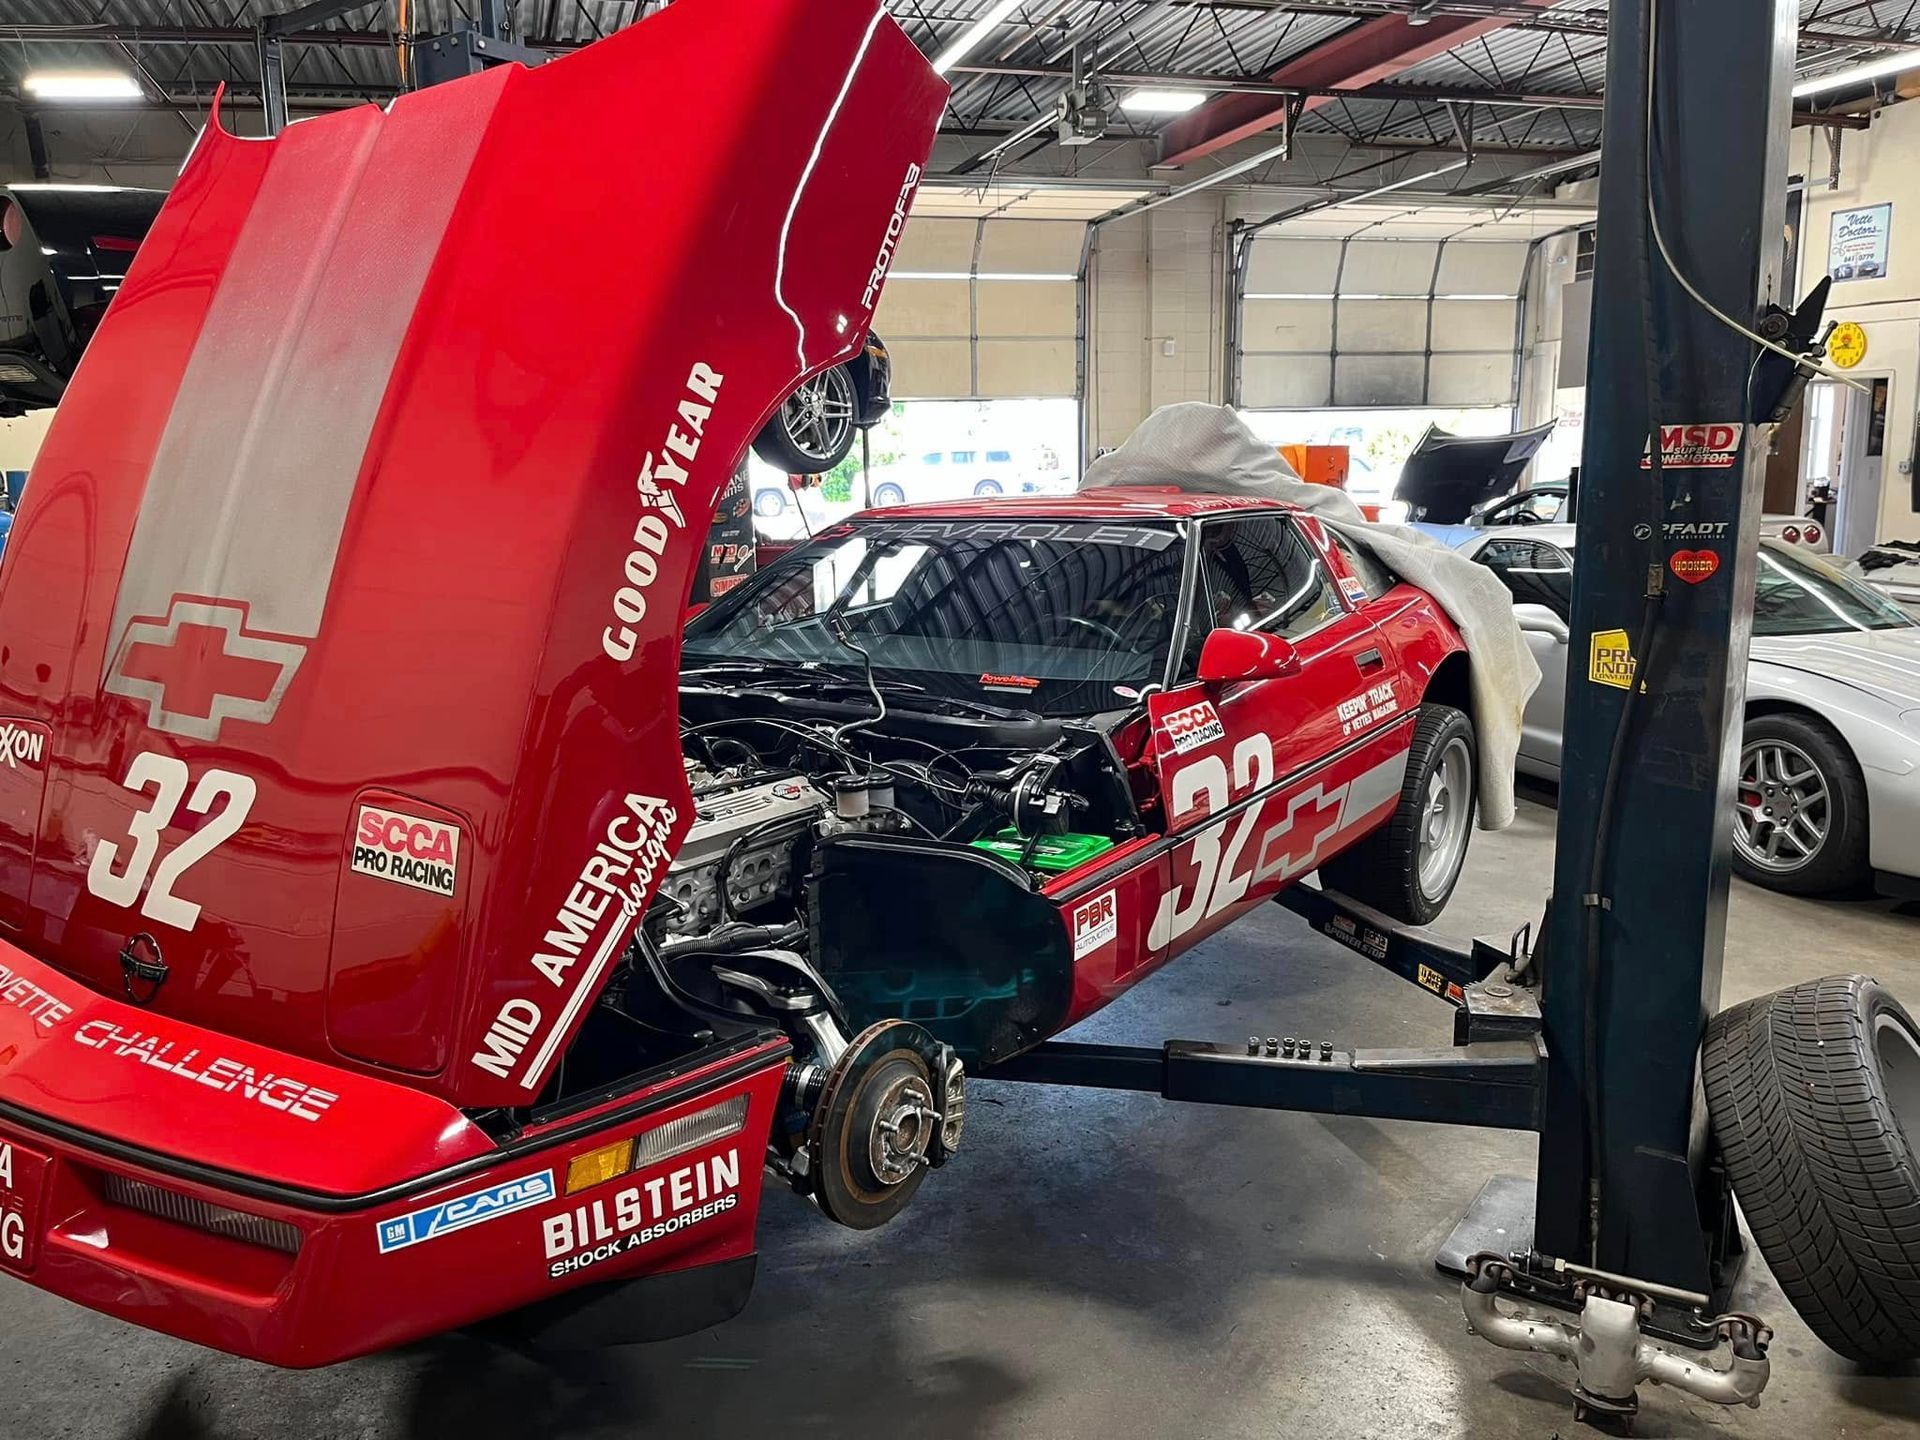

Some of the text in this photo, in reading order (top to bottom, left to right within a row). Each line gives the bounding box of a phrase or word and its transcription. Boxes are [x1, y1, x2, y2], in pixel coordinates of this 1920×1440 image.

[860, 162, 921, 310] PROTOFAB
[1672, 446, 1711, 455] SUPER
[853, 523, 1179, 548] CHEVROLET
[1674, 561, 1713, 571] HOOKER
[1343, 722, 1351, 736] OF
[1371, 699, 1398, 721] MAGAZINE
[1367, 682, 1395, 706] TRACK
[1165, 704, 1218, 736] SCCA
[1174, 722, 1223, 750] PRO RACING
[87, 751, 257, 932] 32
[359, 811, 454, 866] SCCA
[616, 806, 678, 917] designs
[1147, 732, 1274, 951] 32
[353, 845, 453, 891] PRO RACING
[471, 793, 669, 1079] MID AMERICA
[1076, 895, 1114, 936] PBR
[1331, 927, 1361, 949] POWER
[1361, 943, 1386, 959] STOP
[74, 1019, 340, 1122] CHALLENGE
[386, 1178, 548, 1240] GM CAMS
[543, 1148, 740, 1259] BILSTEIN
[551, 1194, 737, 1278] SHOCK ABSORBERS
